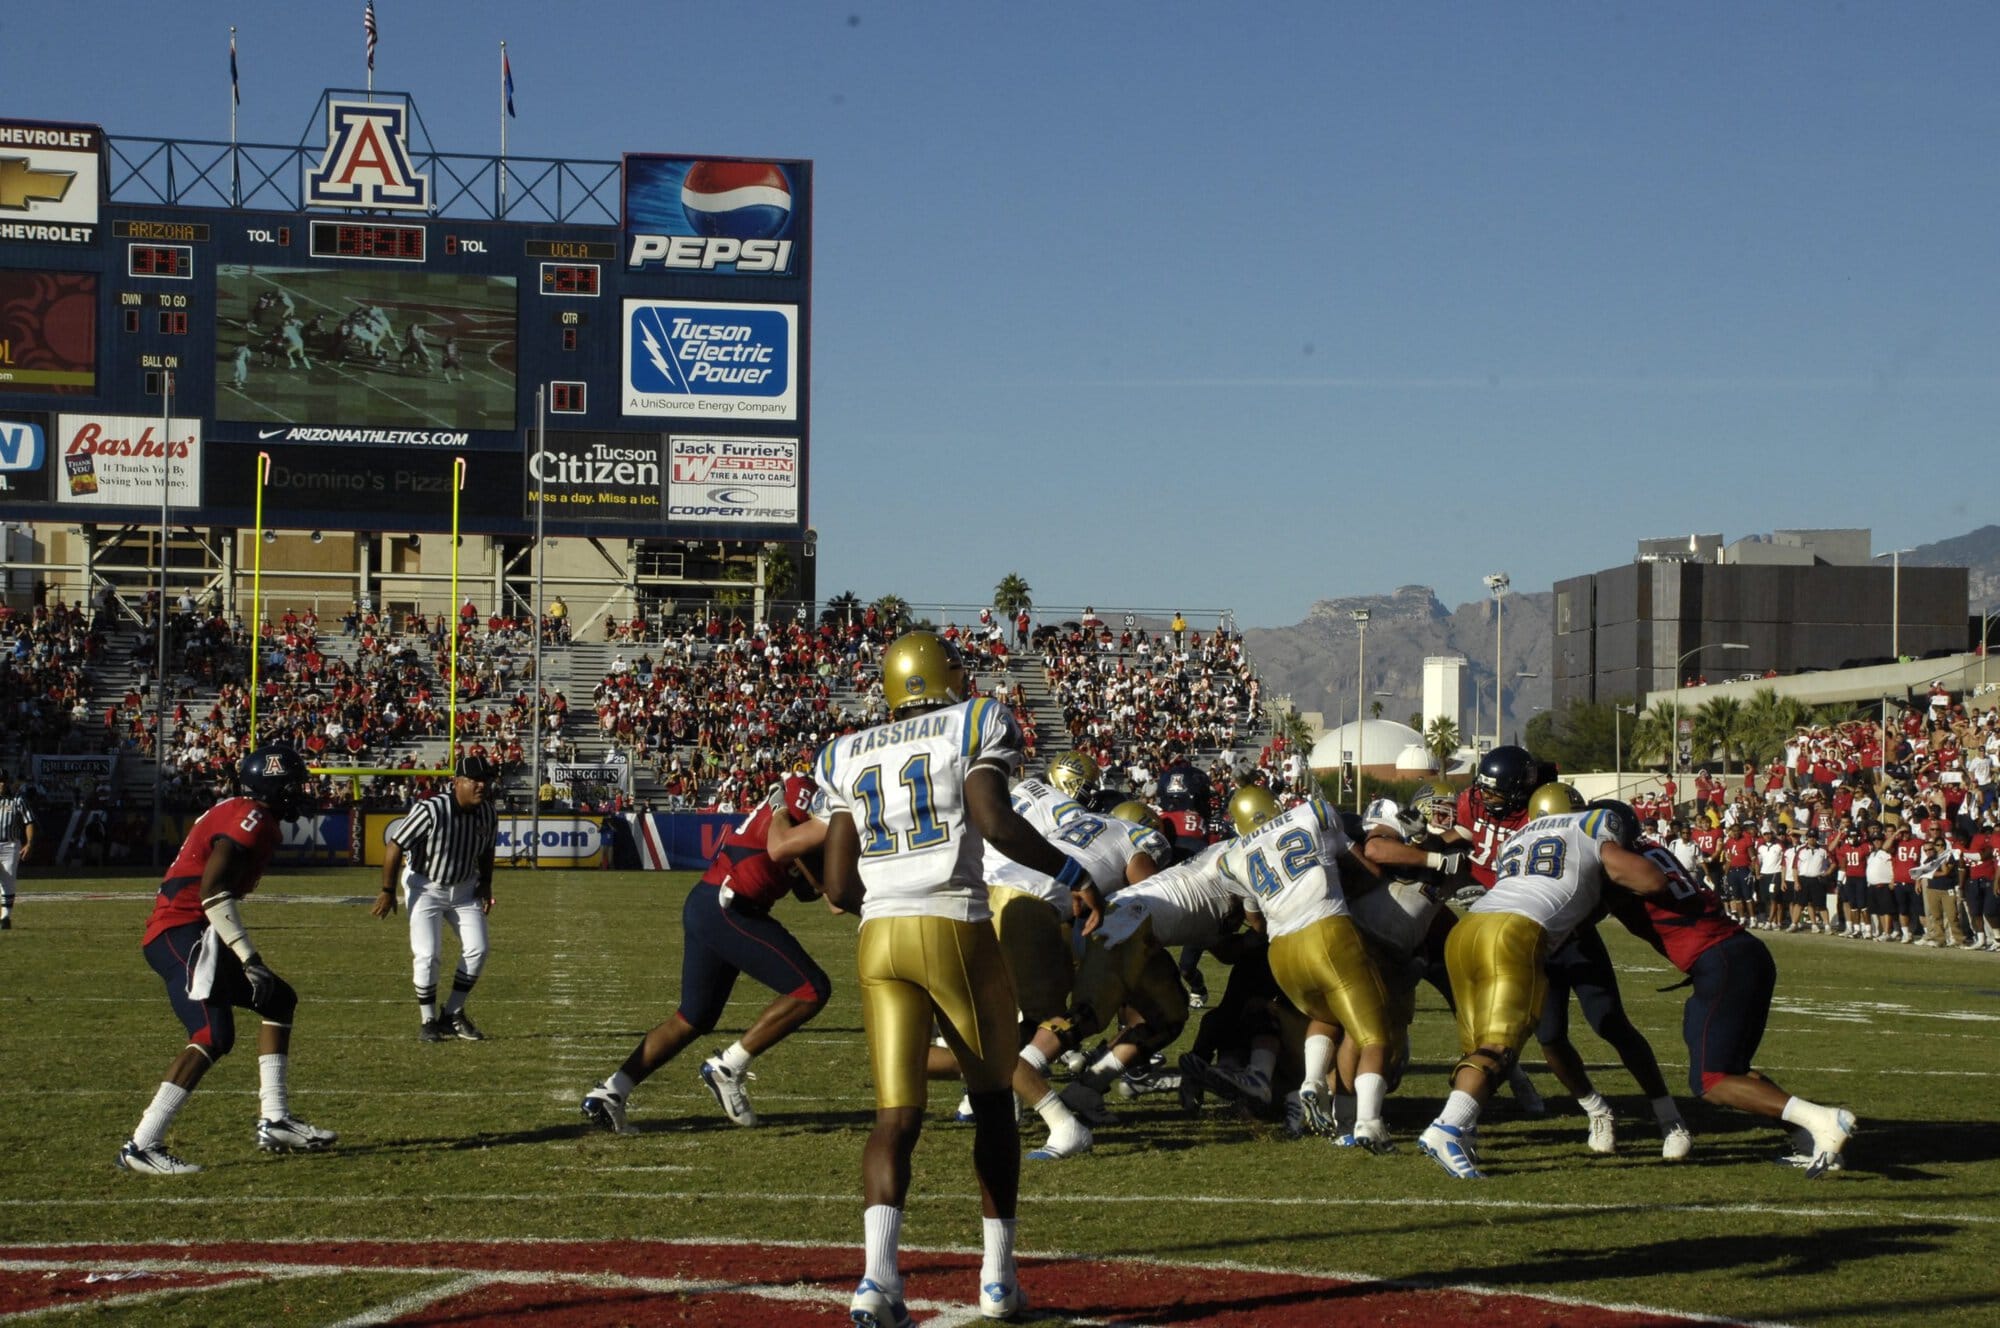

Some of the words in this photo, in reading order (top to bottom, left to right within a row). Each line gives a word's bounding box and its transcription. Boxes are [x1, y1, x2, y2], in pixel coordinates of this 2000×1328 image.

[0, 128, 92, 148] HEVROLET
[305, 100, 428, 210] A
[0, 223, 93, 243] HEVROLET
[128, 222, 195, 240] ARIZONA
[247, 230, 275, 243] TOL
[461, 239, 488, 253] TOL
[551, 243, 588, 258] UCLA
[629, 234, 793, 274] PEPSI
[122, 293, 142, 305] DWN
[160, 295, 171, 307] TO
[173, 295, 187, 307] GO
[562, 312, 578, 324] QTR
[671, 318, 751, 341] Tucson
[679, 341, 773, 363] Electric
[142, 356, 162, 367] BALL
[165, 357, 177, 367] ON
[688, 362, 772, 384] Power
[630, 399, 638, 408] A
[641, 400, 695, 410] UniSource
[698, 401, 734, 412] Energy
[738, 402, 787, 413] Company
[65, 422, 195, 458] Bashas'
[286, 428, 468, 446] ARIZONAATHLETICS.COM
[592, 444, 657, 461] Tucson
[675, 443, 715, 454] Jack
[722, 444, 793, 457] Furrier's
[72, 465, 90, 474] YOU
[103, 464, 111, 472] It
[114, 464, 149, 473] Thanks
[152, 465, 170, 474] Yo
[173, 466, 185, 476] By
[529, 450, 660, 485] Citizen
[674, 456, 793, 482] WESTERN
[99, 476, 131, 487] Saving
[134, 477, 152, 487] You
[273, 467, 385, 490] Domino's
[742, 472, 766, 480] AUTO
[768, 473, 790, 481] CARE
[529, 492, 557, 502] Mss
[560, 494, 568, 503] a
[571, 493, 595, 504] day.
[599, 493, 627, 503] Miss
[630, 495, 637, 504] a
[640, 494, 659, 504] lot.
[1125, 615, 1135, 626] 30
[850, 716, 947, 757] RASSHAN
[263, 755, 286, 776] A
[852, 752, 950, 858] 11
[496, 831, 588, 847] x.com
[1898, 847, 1917, 862] 64
[1247, 827, 1320, 900] 42
